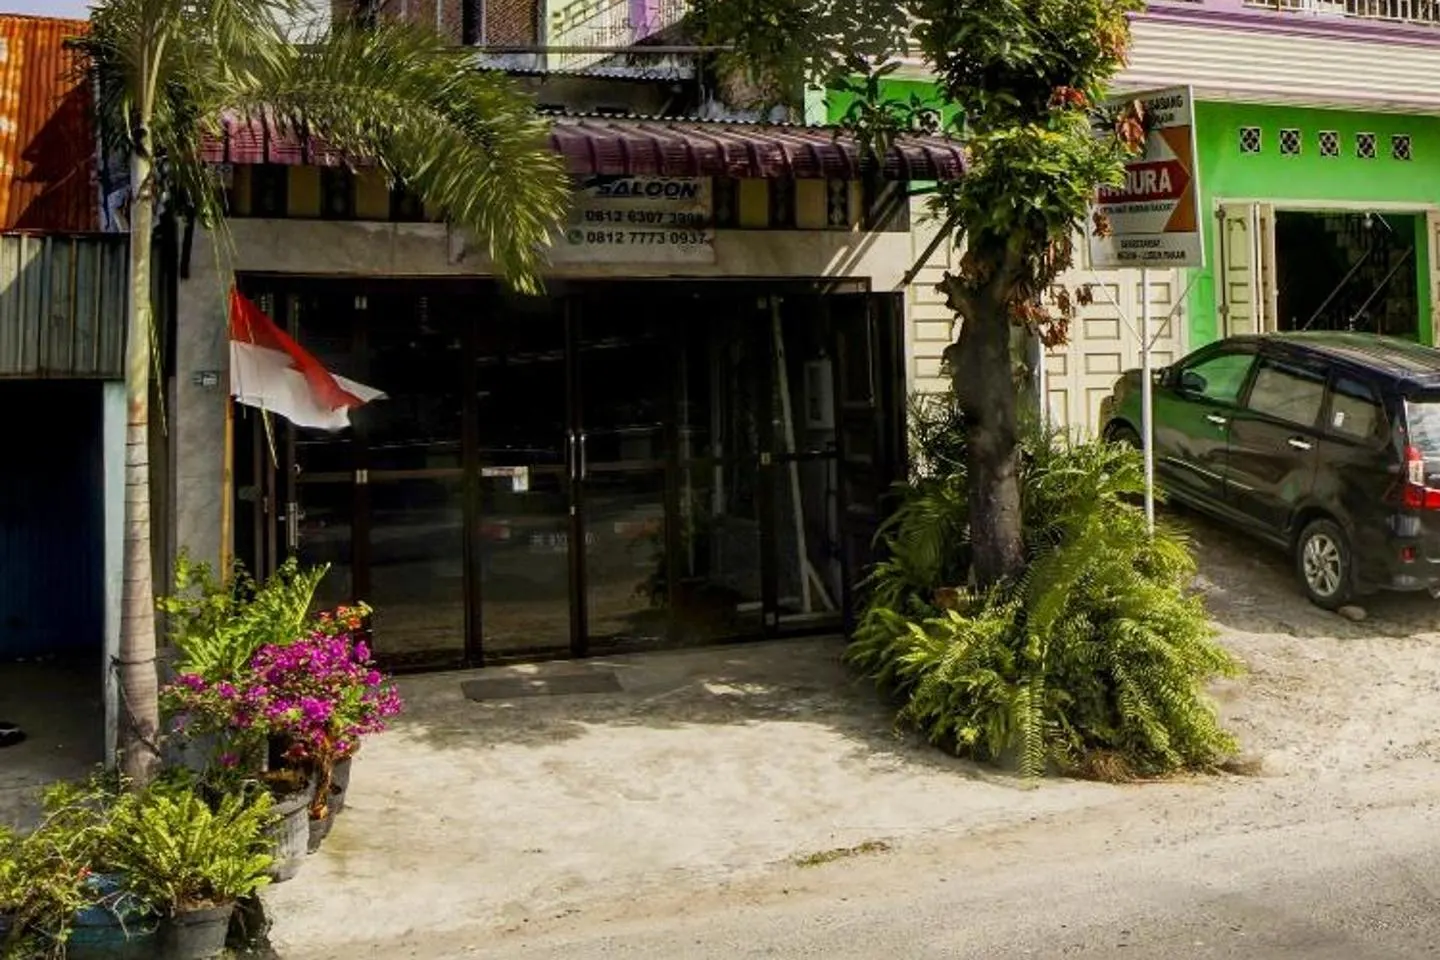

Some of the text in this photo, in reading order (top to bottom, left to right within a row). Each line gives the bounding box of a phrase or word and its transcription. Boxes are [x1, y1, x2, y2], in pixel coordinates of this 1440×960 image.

[595, 180, 698, 198] SALOON
[587, 232, 707, 245] 0812 7773 0937
